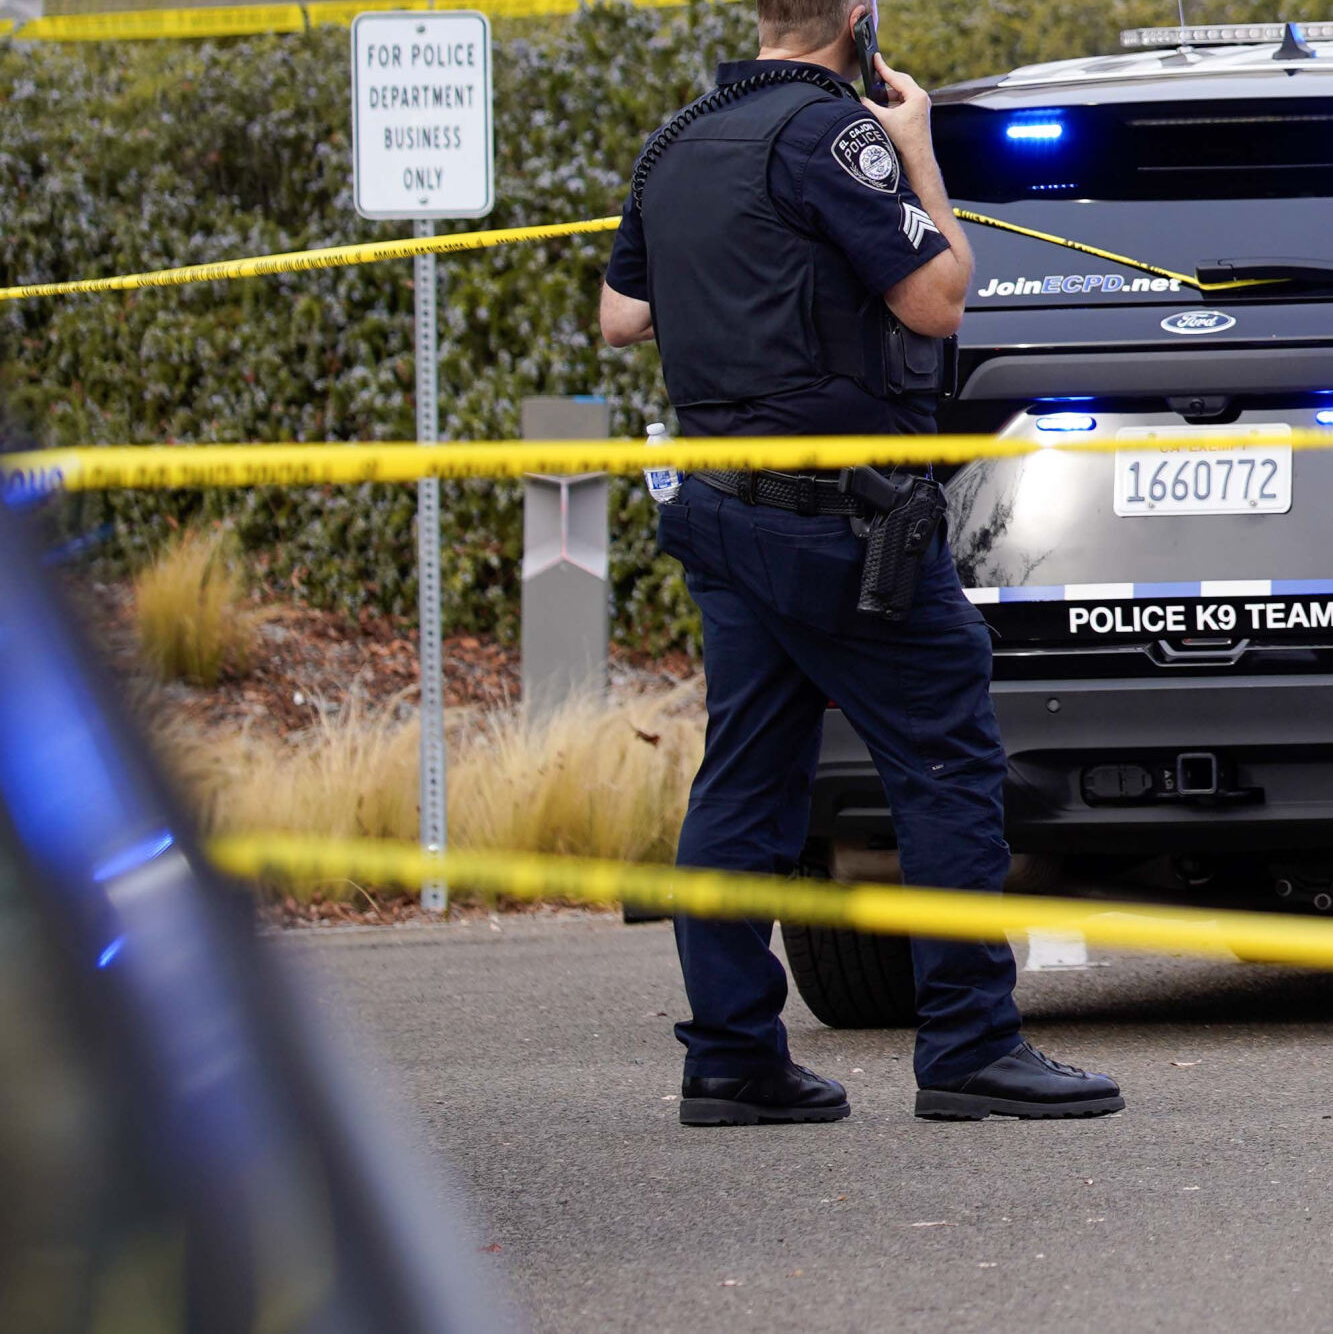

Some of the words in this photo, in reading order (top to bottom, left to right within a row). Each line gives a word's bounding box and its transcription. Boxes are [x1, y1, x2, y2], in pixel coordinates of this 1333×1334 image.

[367, 44, 401, 67] FOR
[411, 43, 475, 66] POLICE
[369, 85, 475, 109] DEPARTMENT
[384, 126, 461, 150] BUSINESS
[839, 139, 849, 151] EL
[849, 123, 875, 139] CAJON
[844, 130, 884, 162] POLICE
[403, 167, 443, 190] ONLY
[978, 274, 1182, 298] JoinECPD.net
[1176, 314, 1219, 329] Ford
[1127, 458, 1278, 502] 1660772
[1069, 605, 1186, 633] POLICE
[1196, 604, 1236, 631] K9
